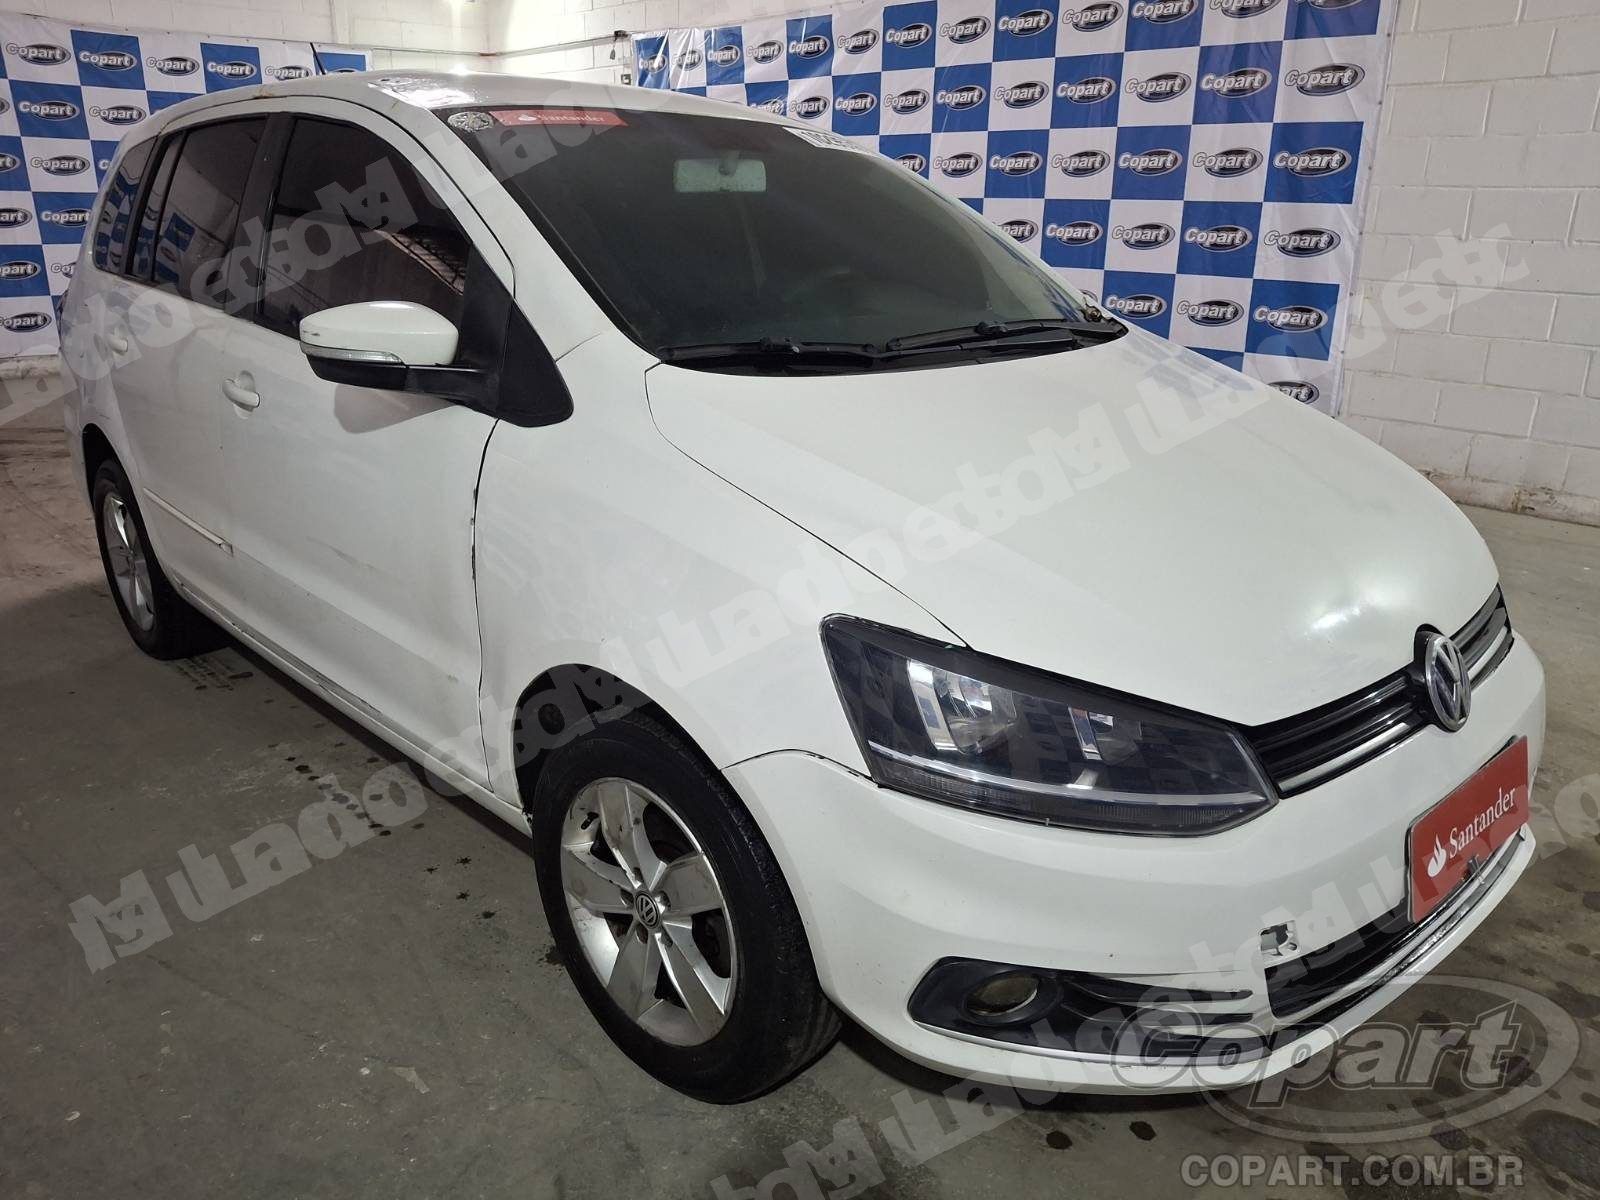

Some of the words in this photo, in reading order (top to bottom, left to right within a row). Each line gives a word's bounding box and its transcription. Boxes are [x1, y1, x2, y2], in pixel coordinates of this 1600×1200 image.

[1063, 5, 1114, 24] Copart
[1133, 0, 1188, 18] Copart
[940, 21, 983, 38] Copart
[998, 12, 1047, 30] Copart
[837, 33, 873, 48] Copart
[886, 26, 926, 43] Copart
[6, 44, 60, 58] Copart
[746, 45, 779, 58] Copart
[789, 38, 824, 53] Copart
[79, 52, 130, 65] Copart
[147, 57, 192, 72] Copart
[208, 62, 250, 75] Copart
[264, 66, 306, 79] Copart
[1286, 67, 1352, 87] Copart
[1125, 79, 1181, 95] Copart
[1202, 70, 1261, 90] Copart
[937, 89, 980, 105] Copart
[995, 84, 1041, 102] Copart
[1057, 80, 1108, 98] Copart
[19, 101, 73, 115] Copart
[789, 99, 824, 113] Copart
[835, 95, 871, 110] Copart
[884, 93, 923, 108] Copart
[89, 106, 138, 121] Copart
[31, 157, 81, 169] Copart
[933, 156, 978, 172] Copart
[990, 155, 1036, 171] Copart
[1051, 153, 1101, 171] Copart
[1120, 152, 1174, 169] Copart
[1193, 151, 1252, 170] Copart
[1274, 152, 1340, 170] Copart
[1046, 225, 1096, 241] Copart
[1112, 226, 1166, 243] Copart
[1185, 228, 1242, 245] Copart
[1265, 231, 1329, 248] Copart
[1106, 296, 1159, 313] Copart
[1177, 301, 1234, 319] Copart
[1254, 307, 1316, 327] Copart
[1449, 784, 1515, 859] Santander
